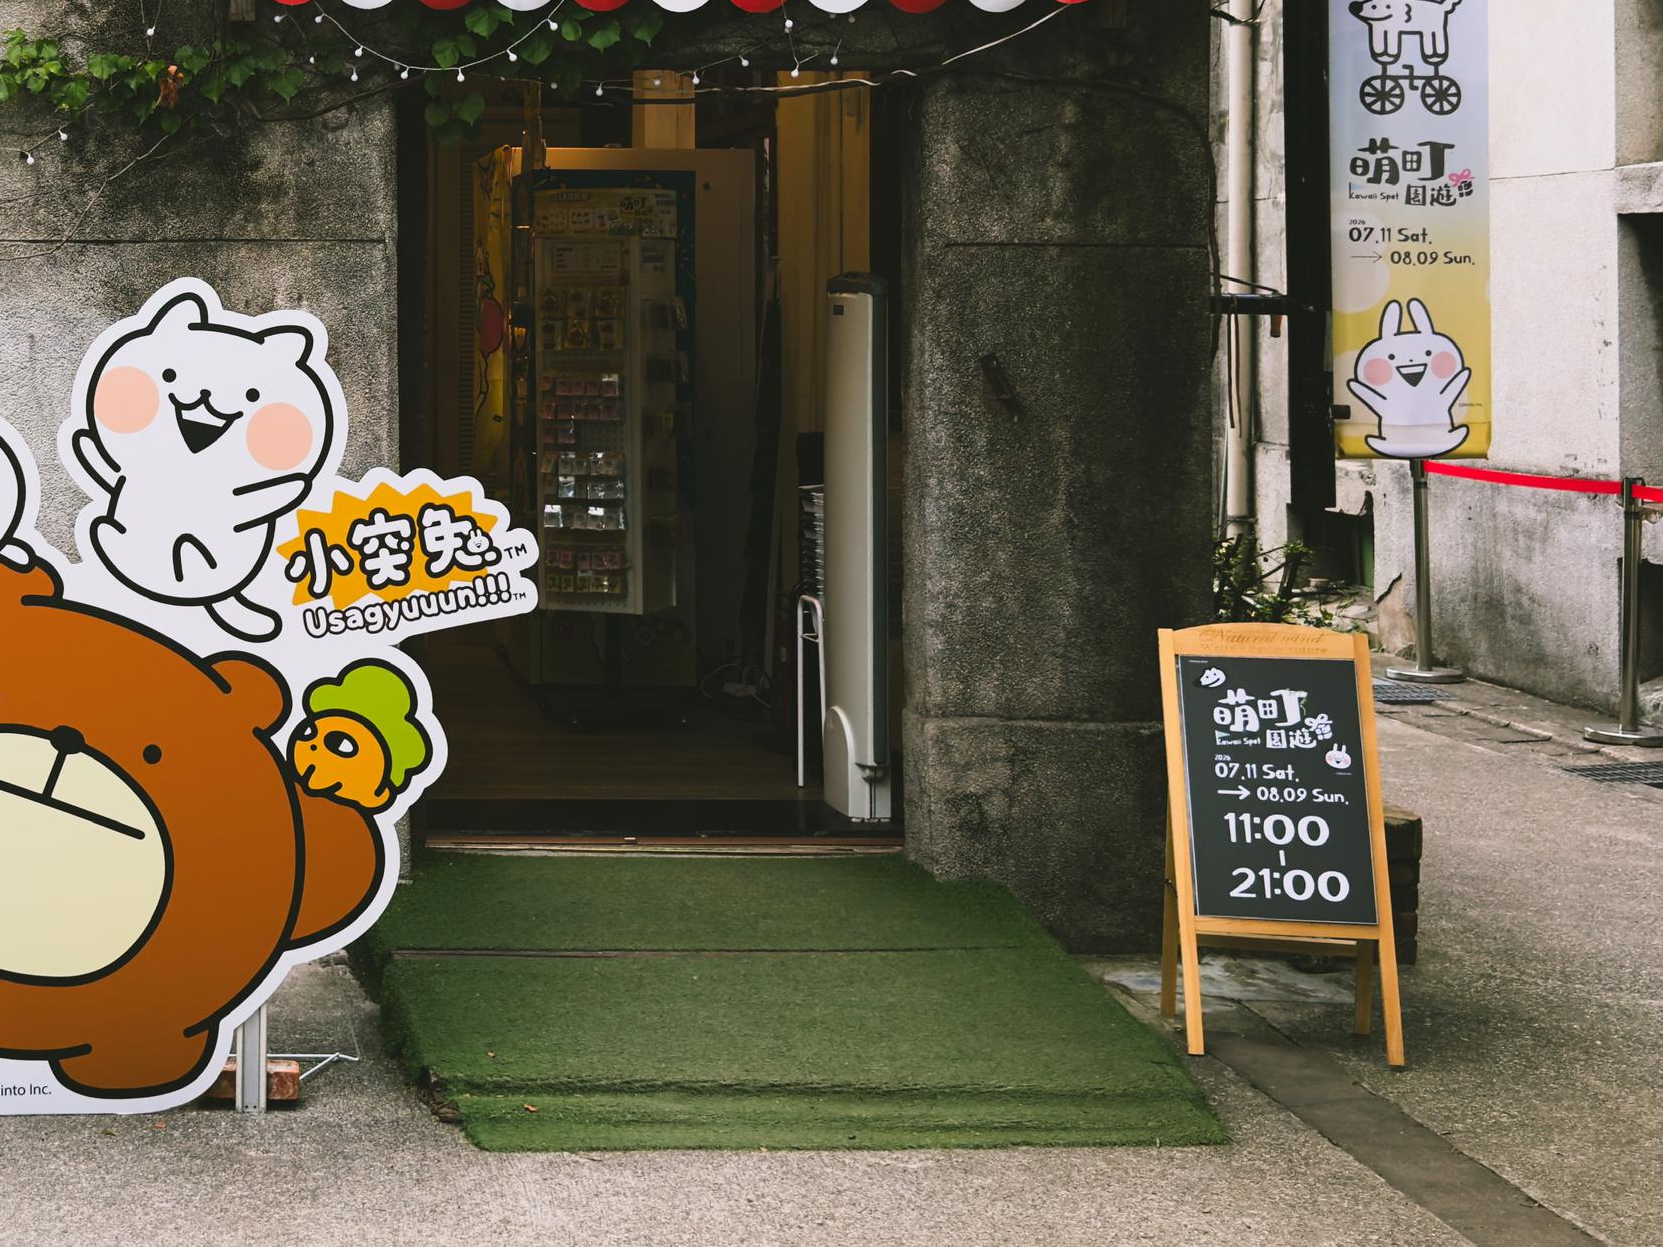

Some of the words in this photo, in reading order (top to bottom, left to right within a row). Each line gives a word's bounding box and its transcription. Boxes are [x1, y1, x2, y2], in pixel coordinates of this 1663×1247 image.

[1349, 137, 1456, 185] 萌町
[1349, 227, 1391, 243] 07.11
[1398, 228, 1432, 244] Sat.
[1391, 251, 1438, 265] 08.09
[1444, 251, 1474, 265] Sun.
[302, 571, 512, 639] Usagyuuun!!!
[1213, 688, 1308, 732] 萌町
[1215, 763, 1256, 780] 07.11
[1263, 765, 1299, 782] Sat.
[1257, 787, 1307, 802] 08.09
[1312, 789, 1348, 804] Sun.
[1224, 813, 1329, 846] 11:00
[1230, 868, 1349, 901] 21:00
[29, 1083, 52, 1095] Inc.
